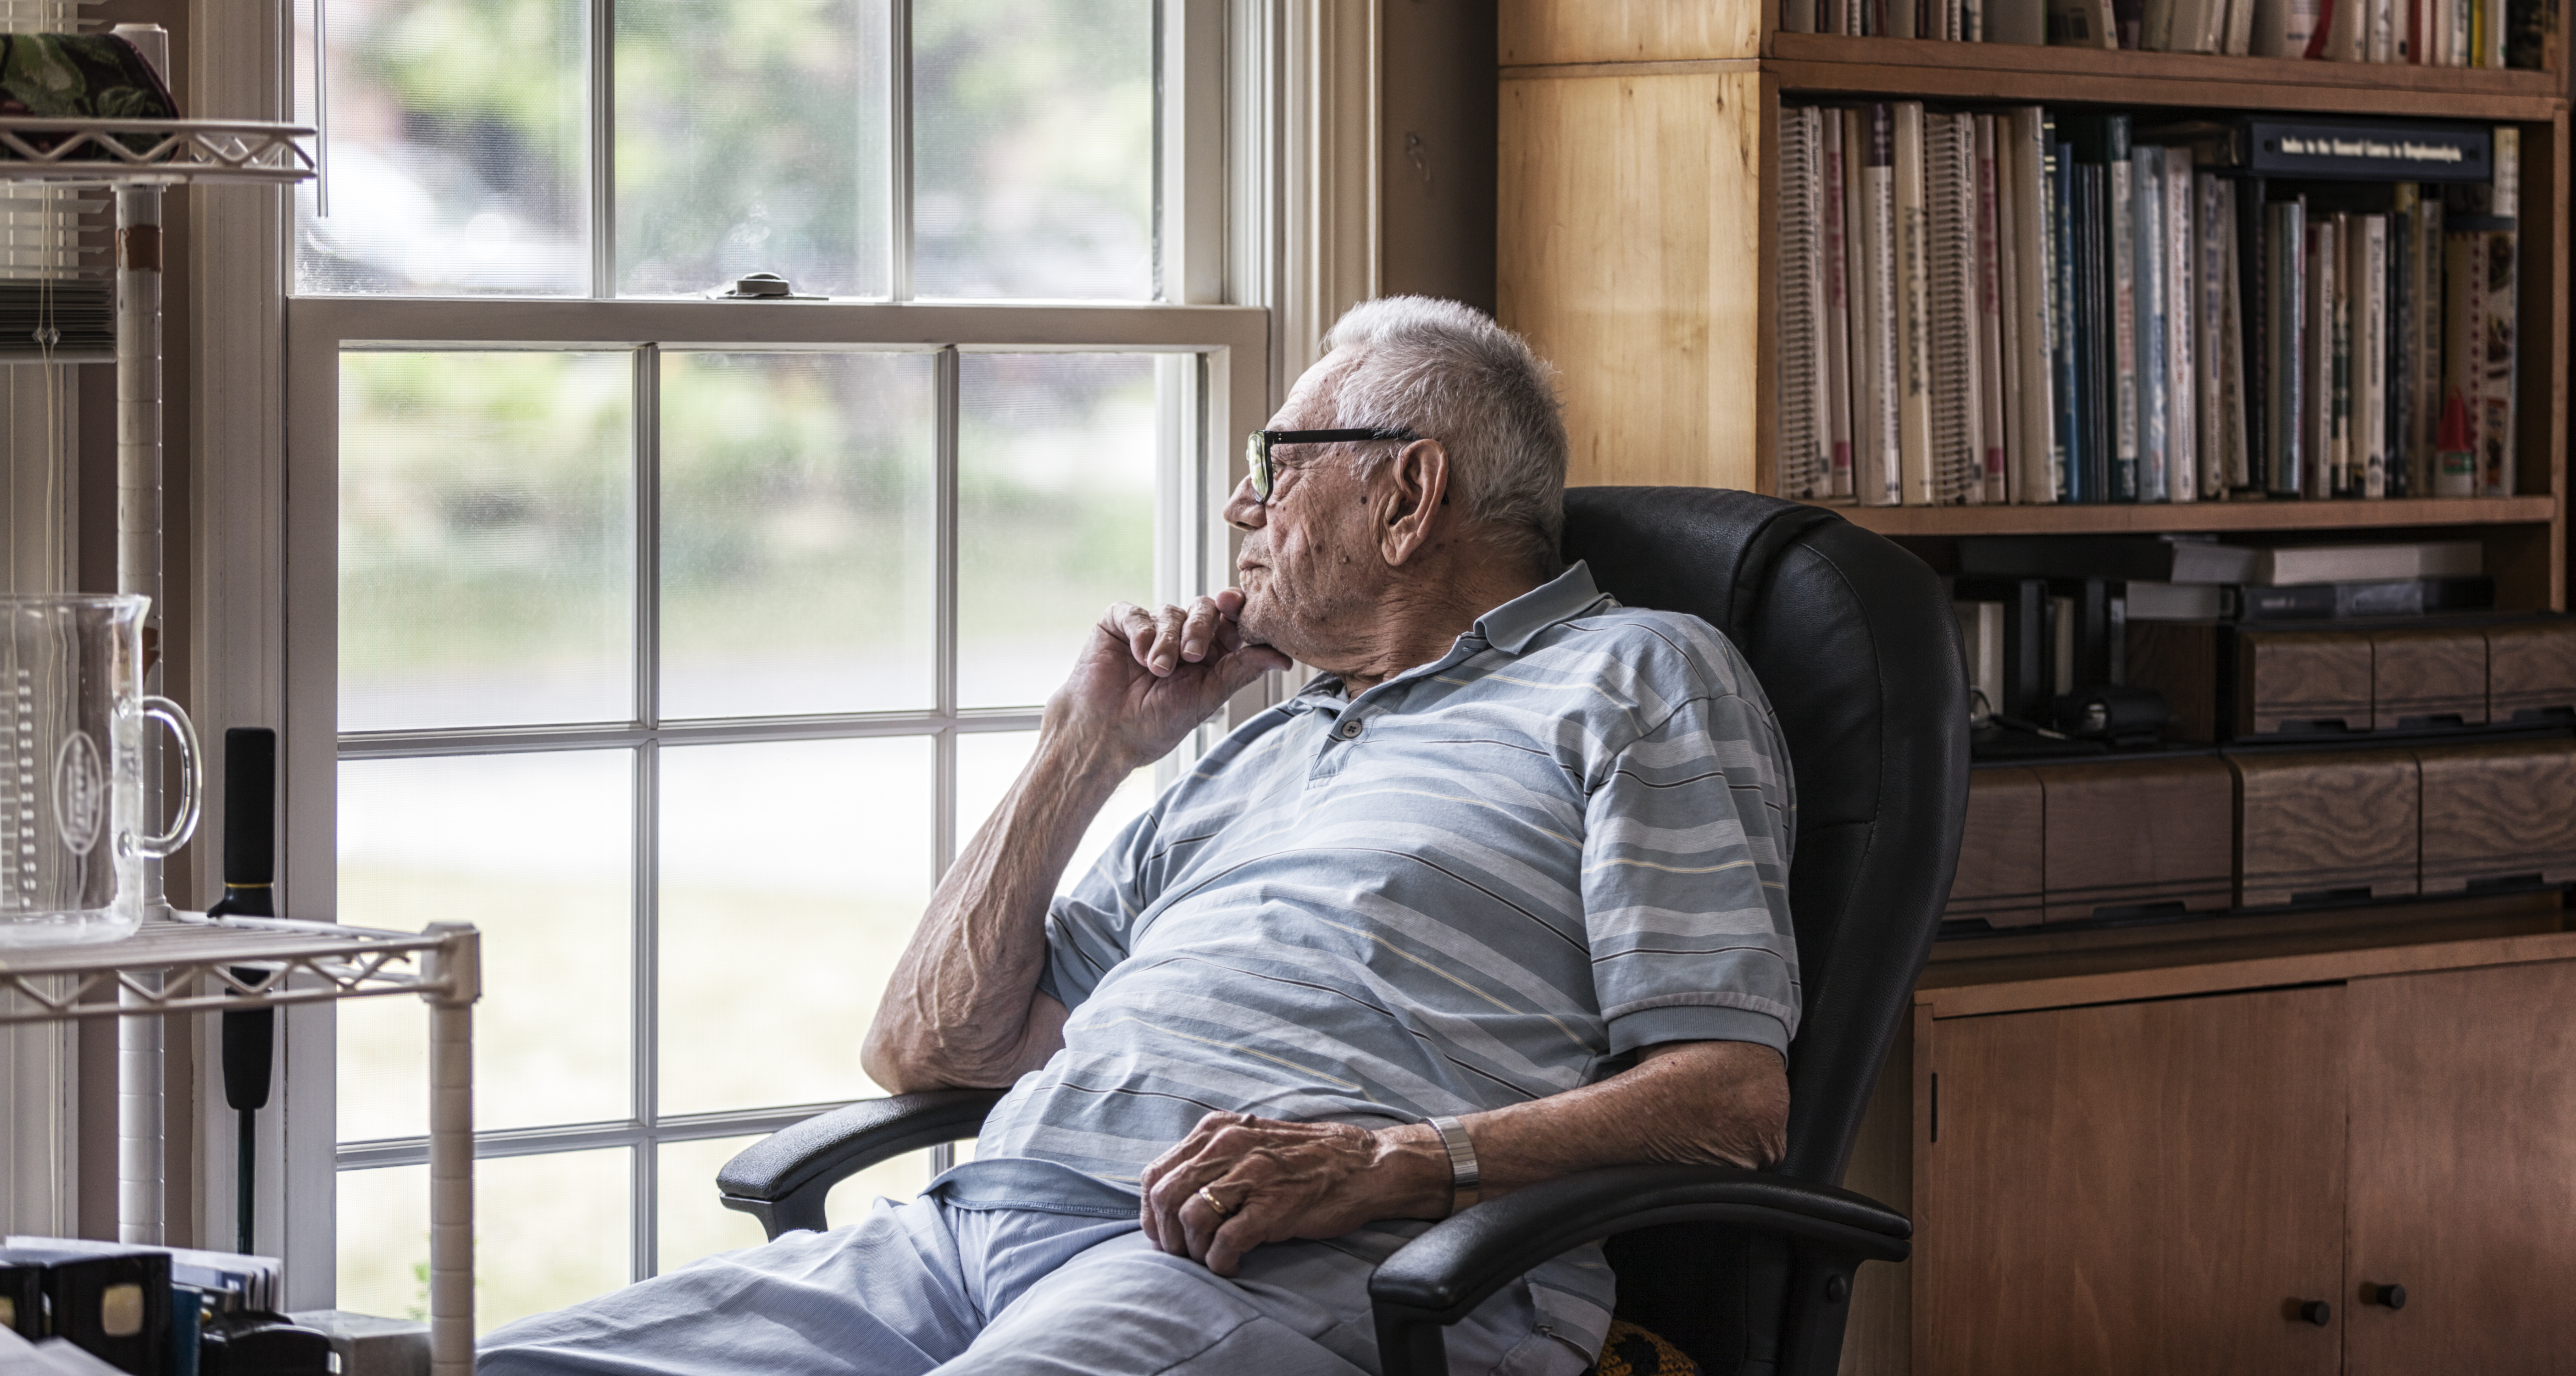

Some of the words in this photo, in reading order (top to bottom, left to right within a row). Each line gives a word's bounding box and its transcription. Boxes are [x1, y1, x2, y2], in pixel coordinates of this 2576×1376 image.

[2306, 139, 2316, 155] to
[2318, 138, 2331, 155] the
[1904, 205, 1921, 271] Menu
[1907, 274, 1926, 398] Cookbook
